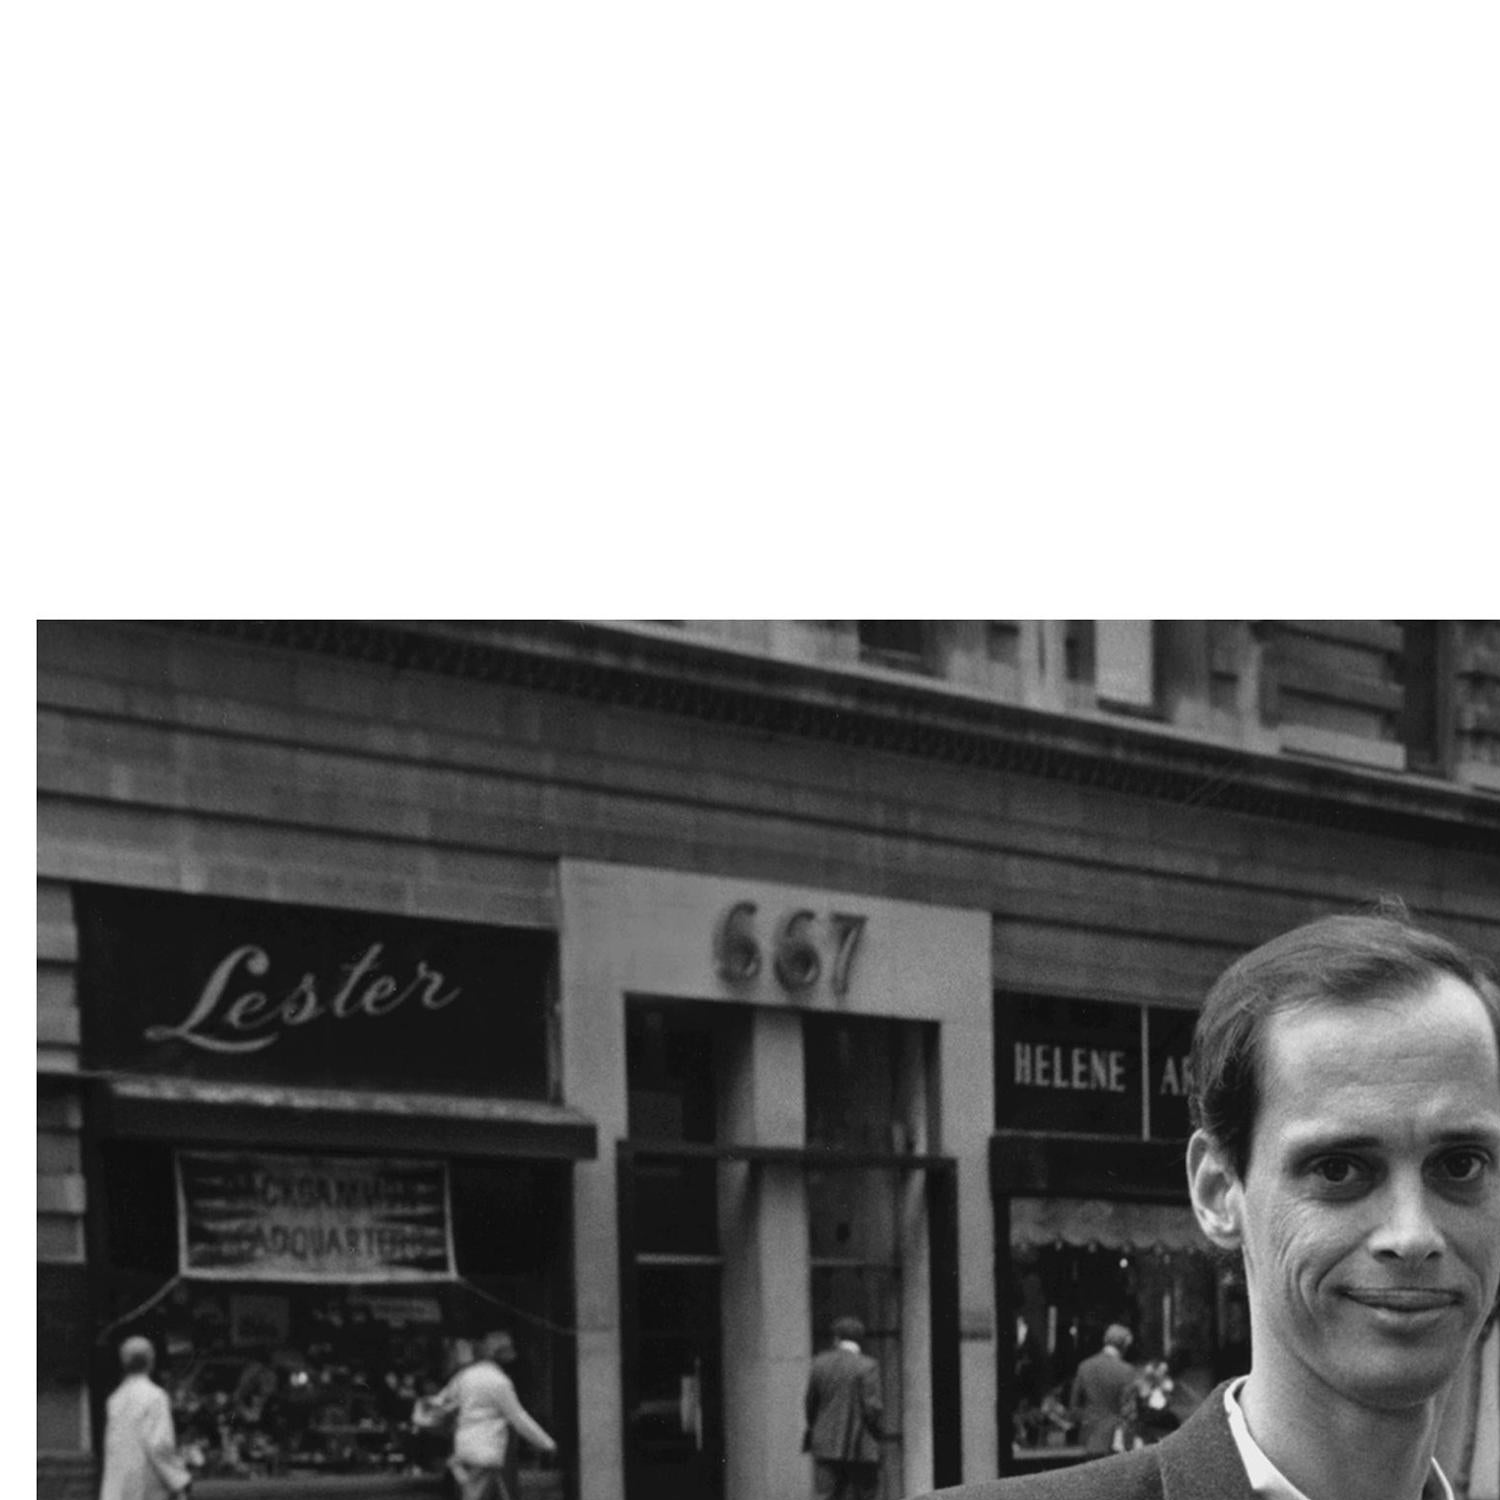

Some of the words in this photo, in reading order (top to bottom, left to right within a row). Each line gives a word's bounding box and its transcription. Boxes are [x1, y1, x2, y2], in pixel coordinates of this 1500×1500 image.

[712, 901, 868, 996] 667
[144, 942, 461, 1053] Lester
[1013, 1041, 1126, 1093] HELENE
